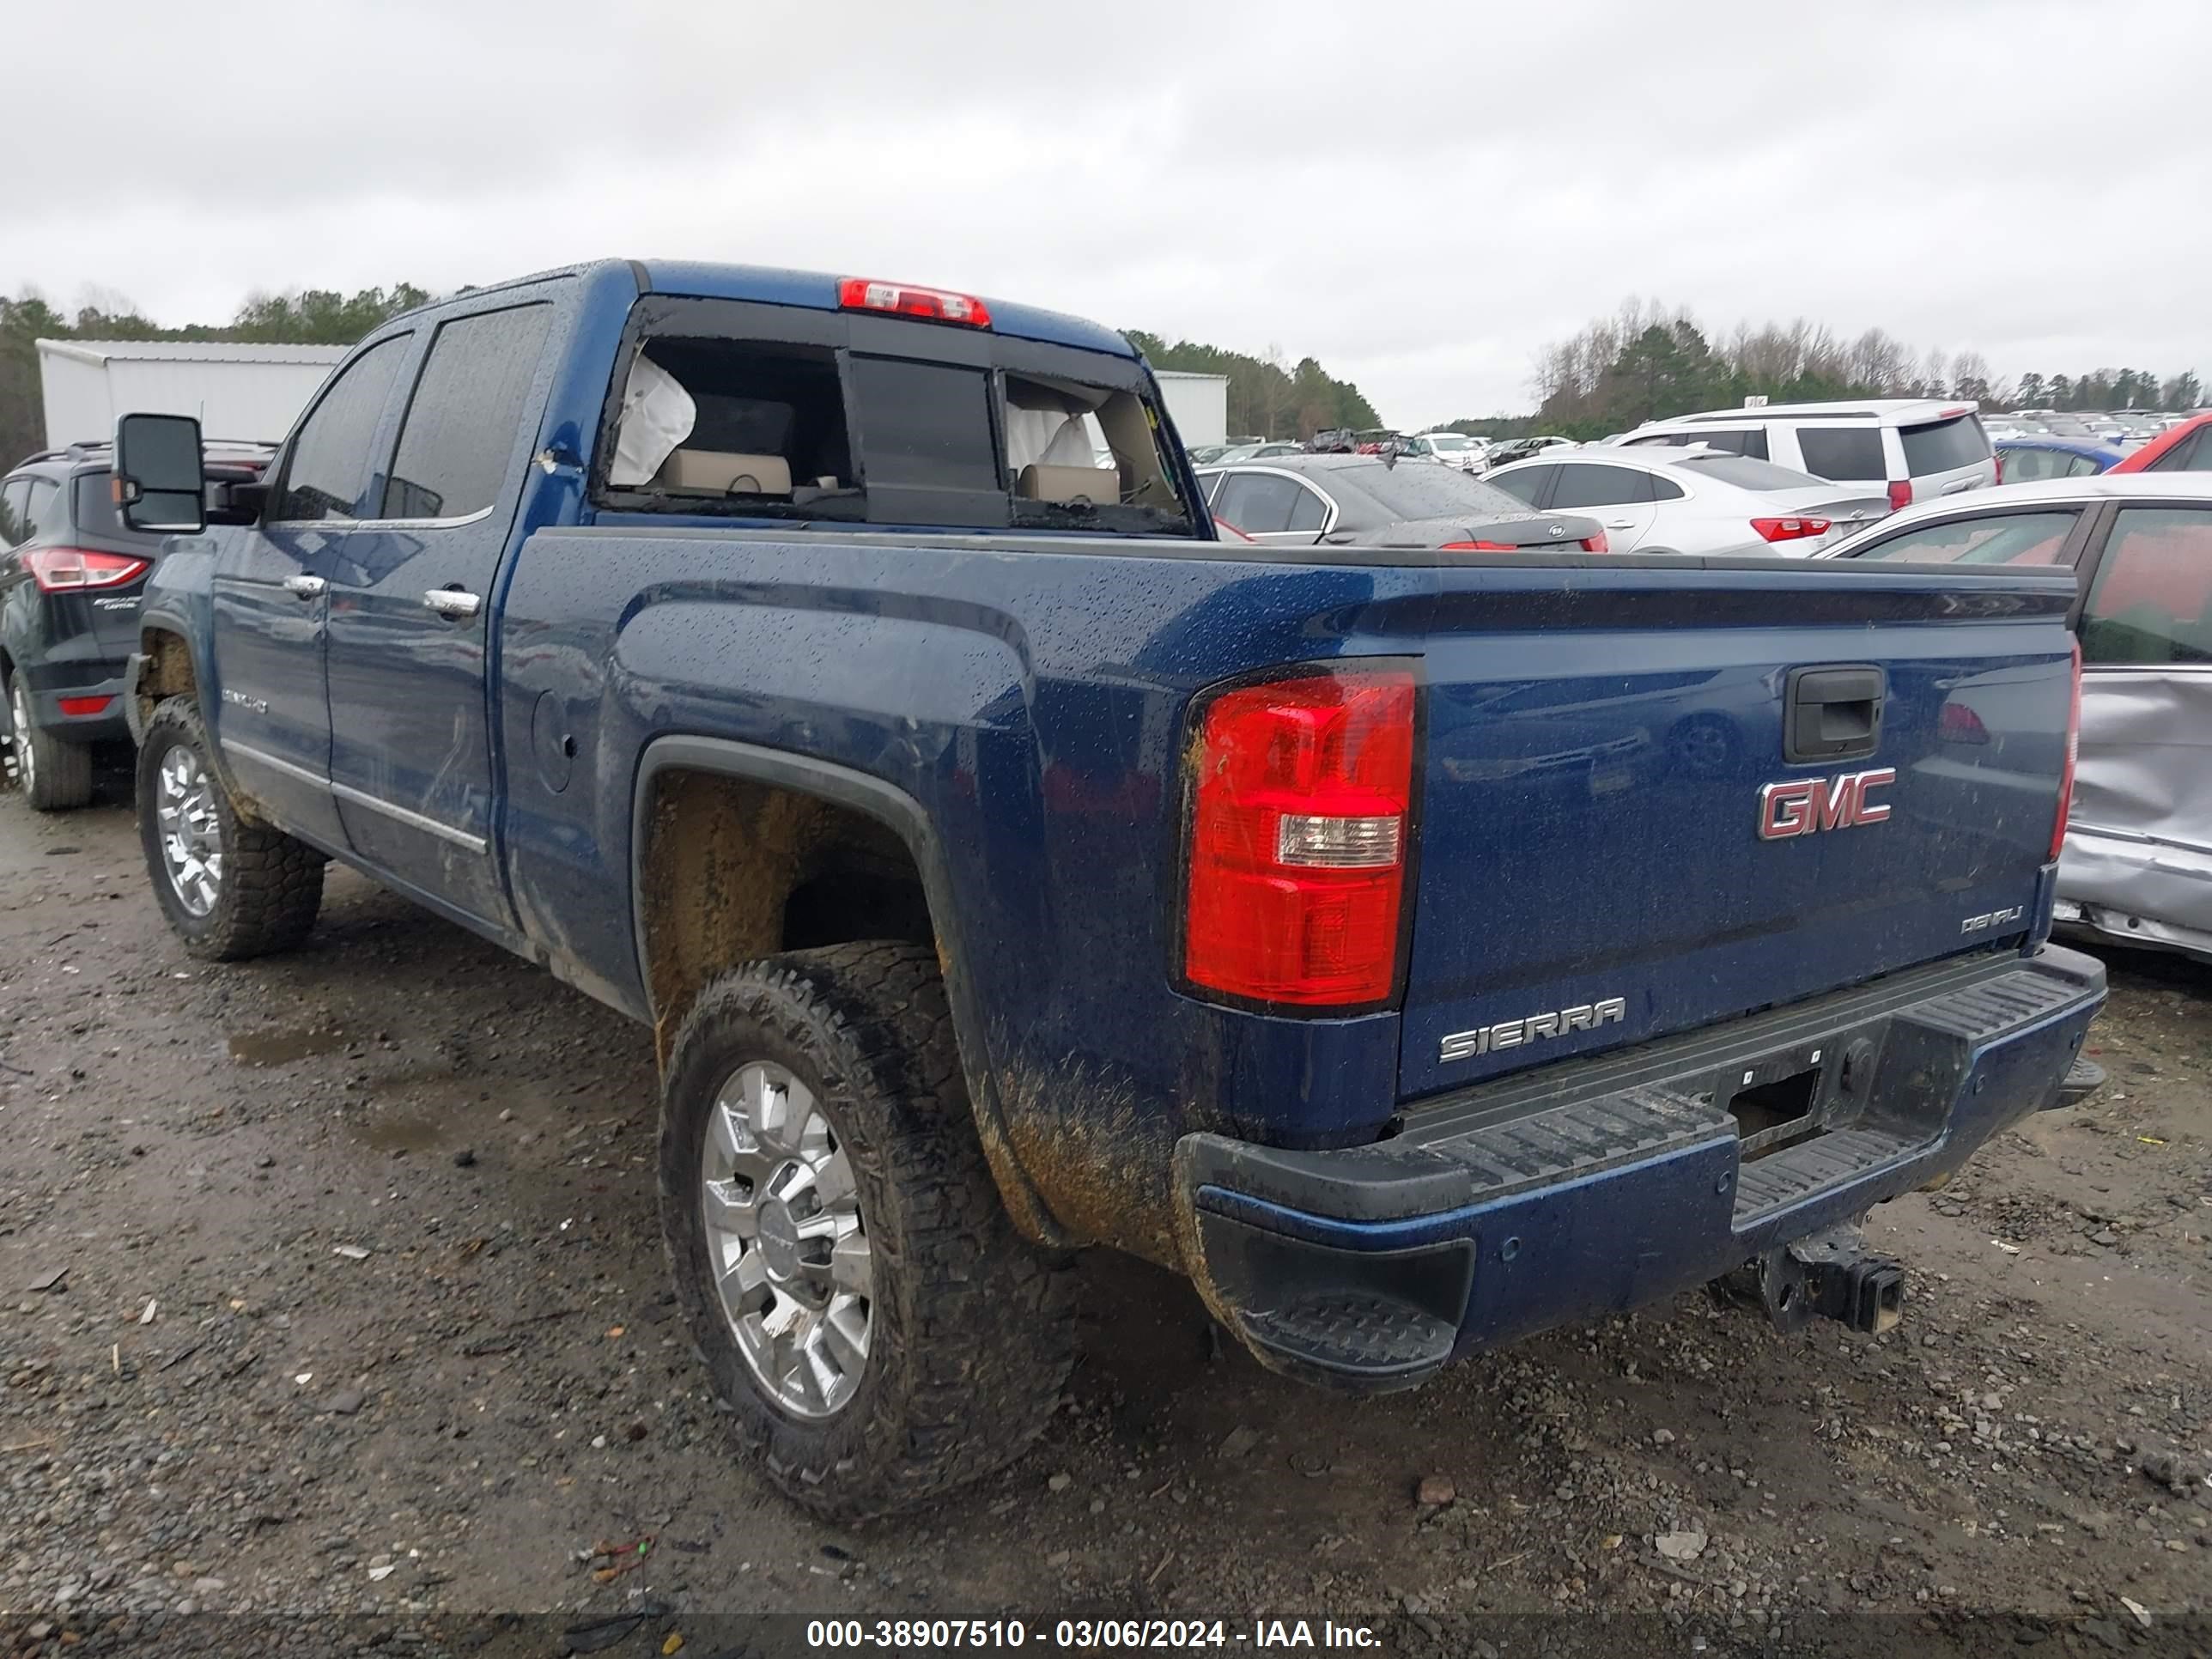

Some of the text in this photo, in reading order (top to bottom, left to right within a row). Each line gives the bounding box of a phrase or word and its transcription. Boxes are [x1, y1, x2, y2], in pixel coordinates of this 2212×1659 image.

[1757, 767, 1896, 841] GMC
[1960, 905, 2024, 934] DENALI
[1438, 996, 1626, 1065] SIERRA
